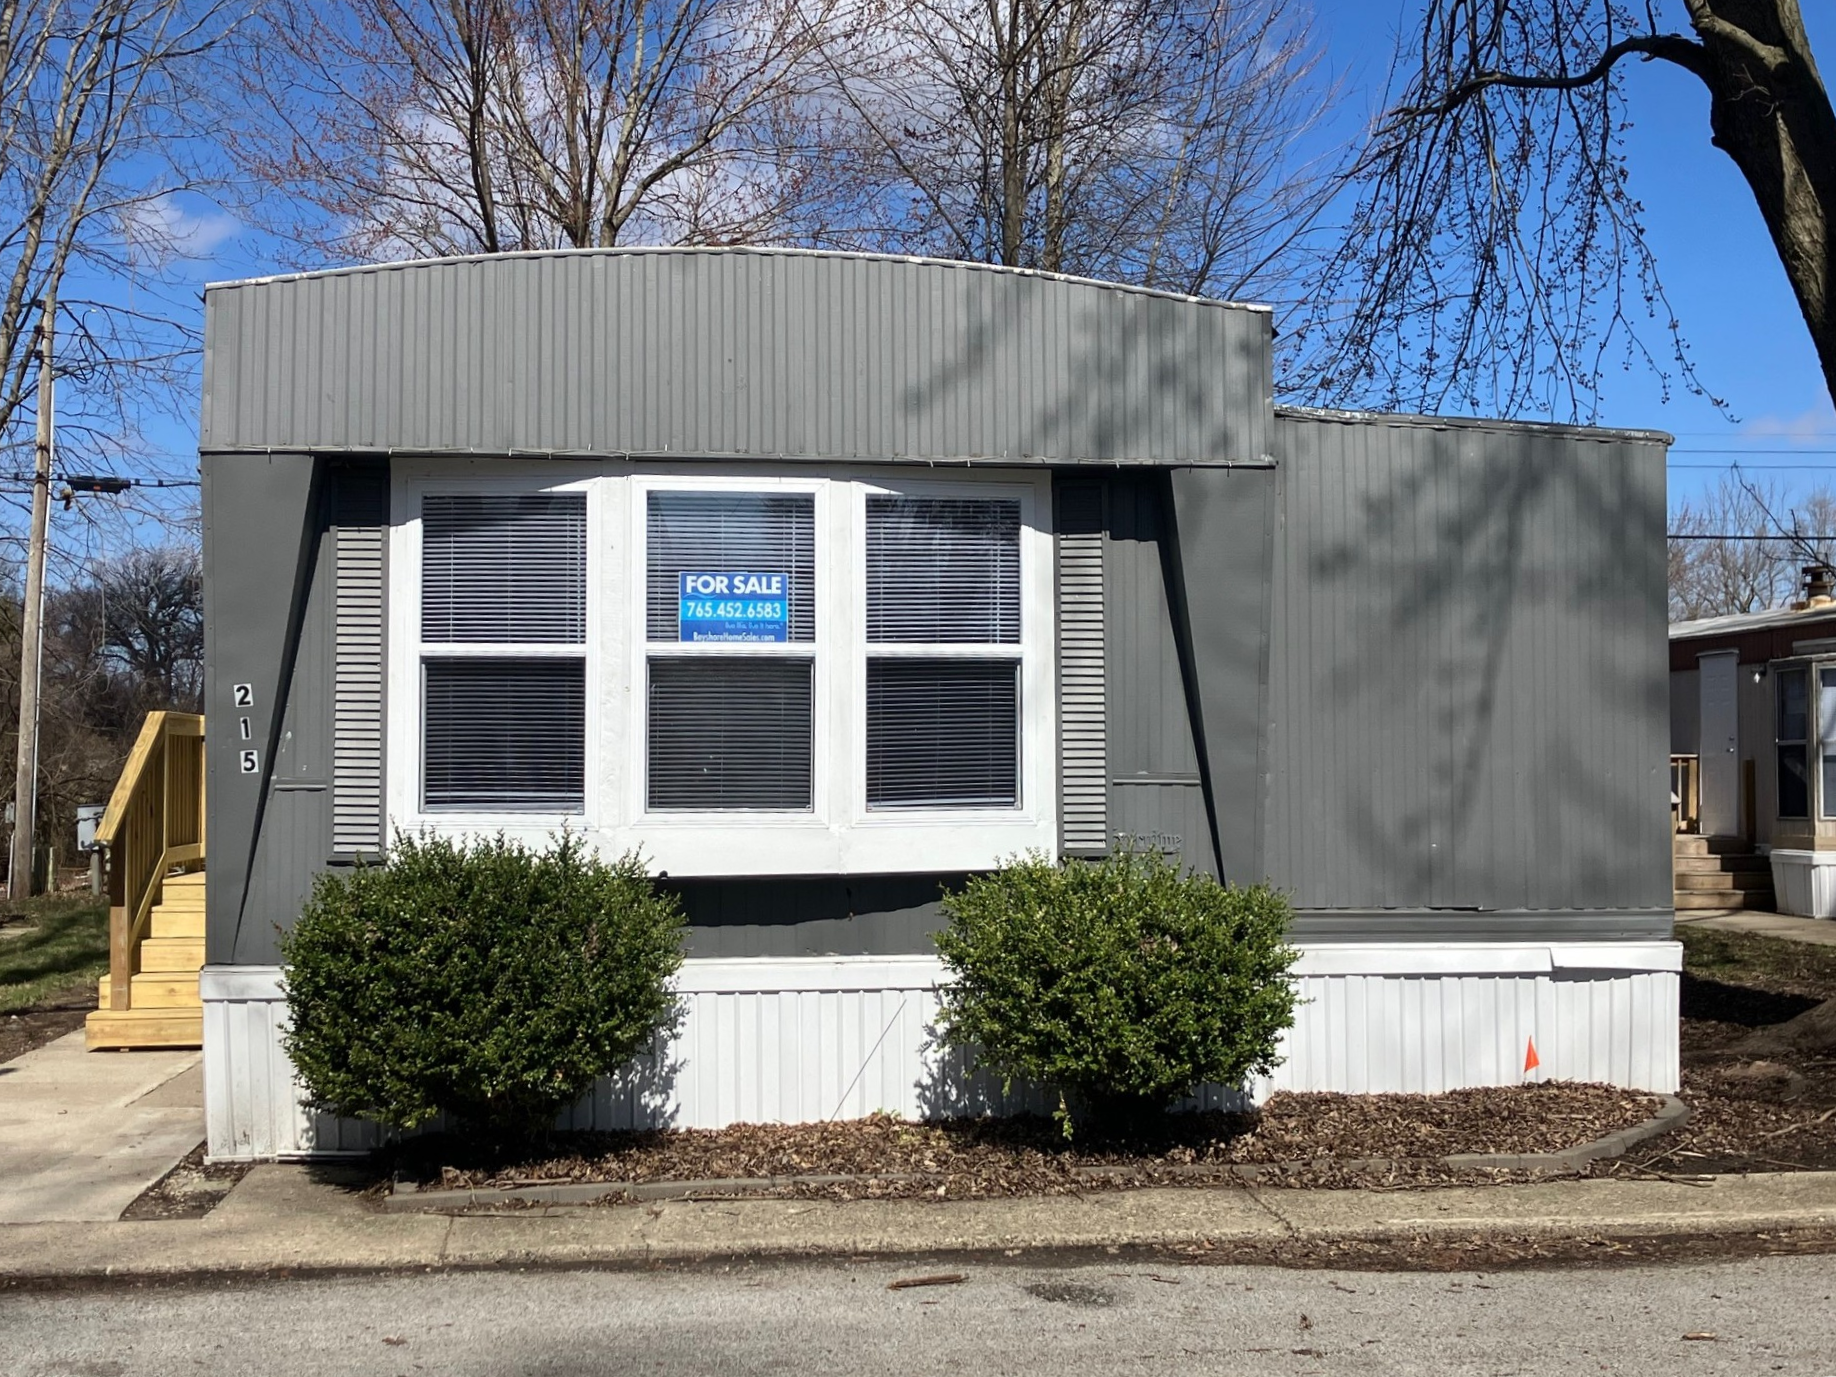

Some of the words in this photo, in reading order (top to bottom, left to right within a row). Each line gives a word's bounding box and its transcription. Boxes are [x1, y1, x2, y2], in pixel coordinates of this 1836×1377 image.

[686, 575, 729, 594] FOR
[733, 576, 781, 594] SALE
[687, 602, 781, 618] 765.452.6583
[693, 631, 775, 642] BayshoreHomeSales.com
